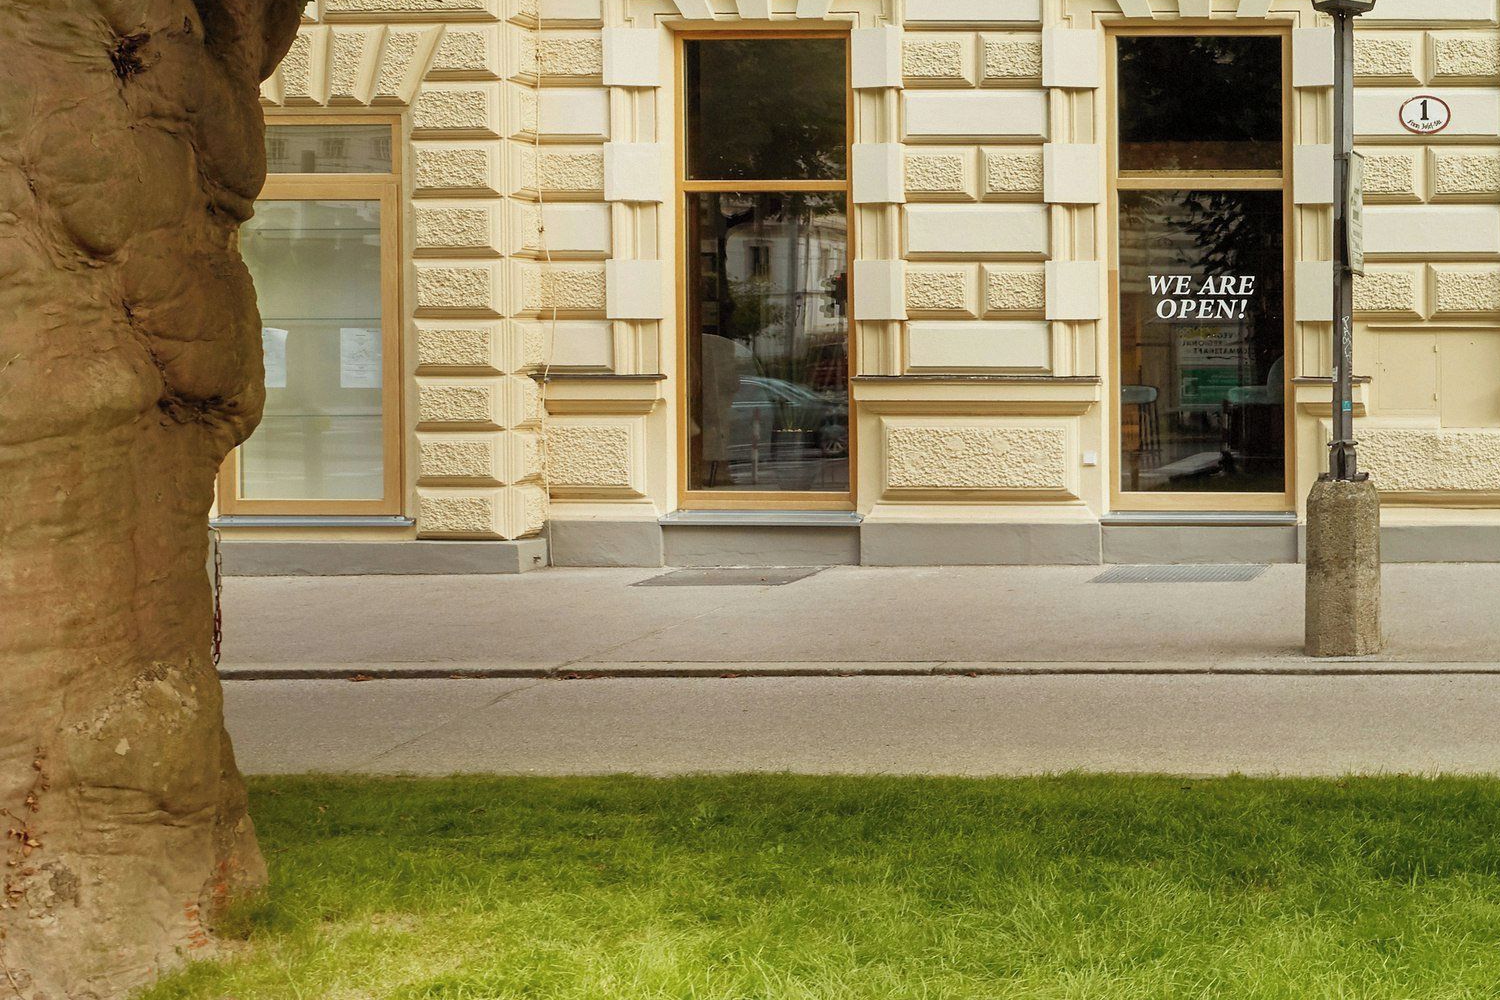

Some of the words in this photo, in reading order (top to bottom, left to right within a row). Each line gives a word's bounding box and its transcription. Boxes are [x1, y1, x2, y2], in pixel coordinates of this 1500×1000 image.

[1420, 99, 1430, 121] 1
[1147, 275, 1192, 295] WE
[1196, 275, 1256, 295] ARE
[1156, 298, 1248, 319] OPEN!
